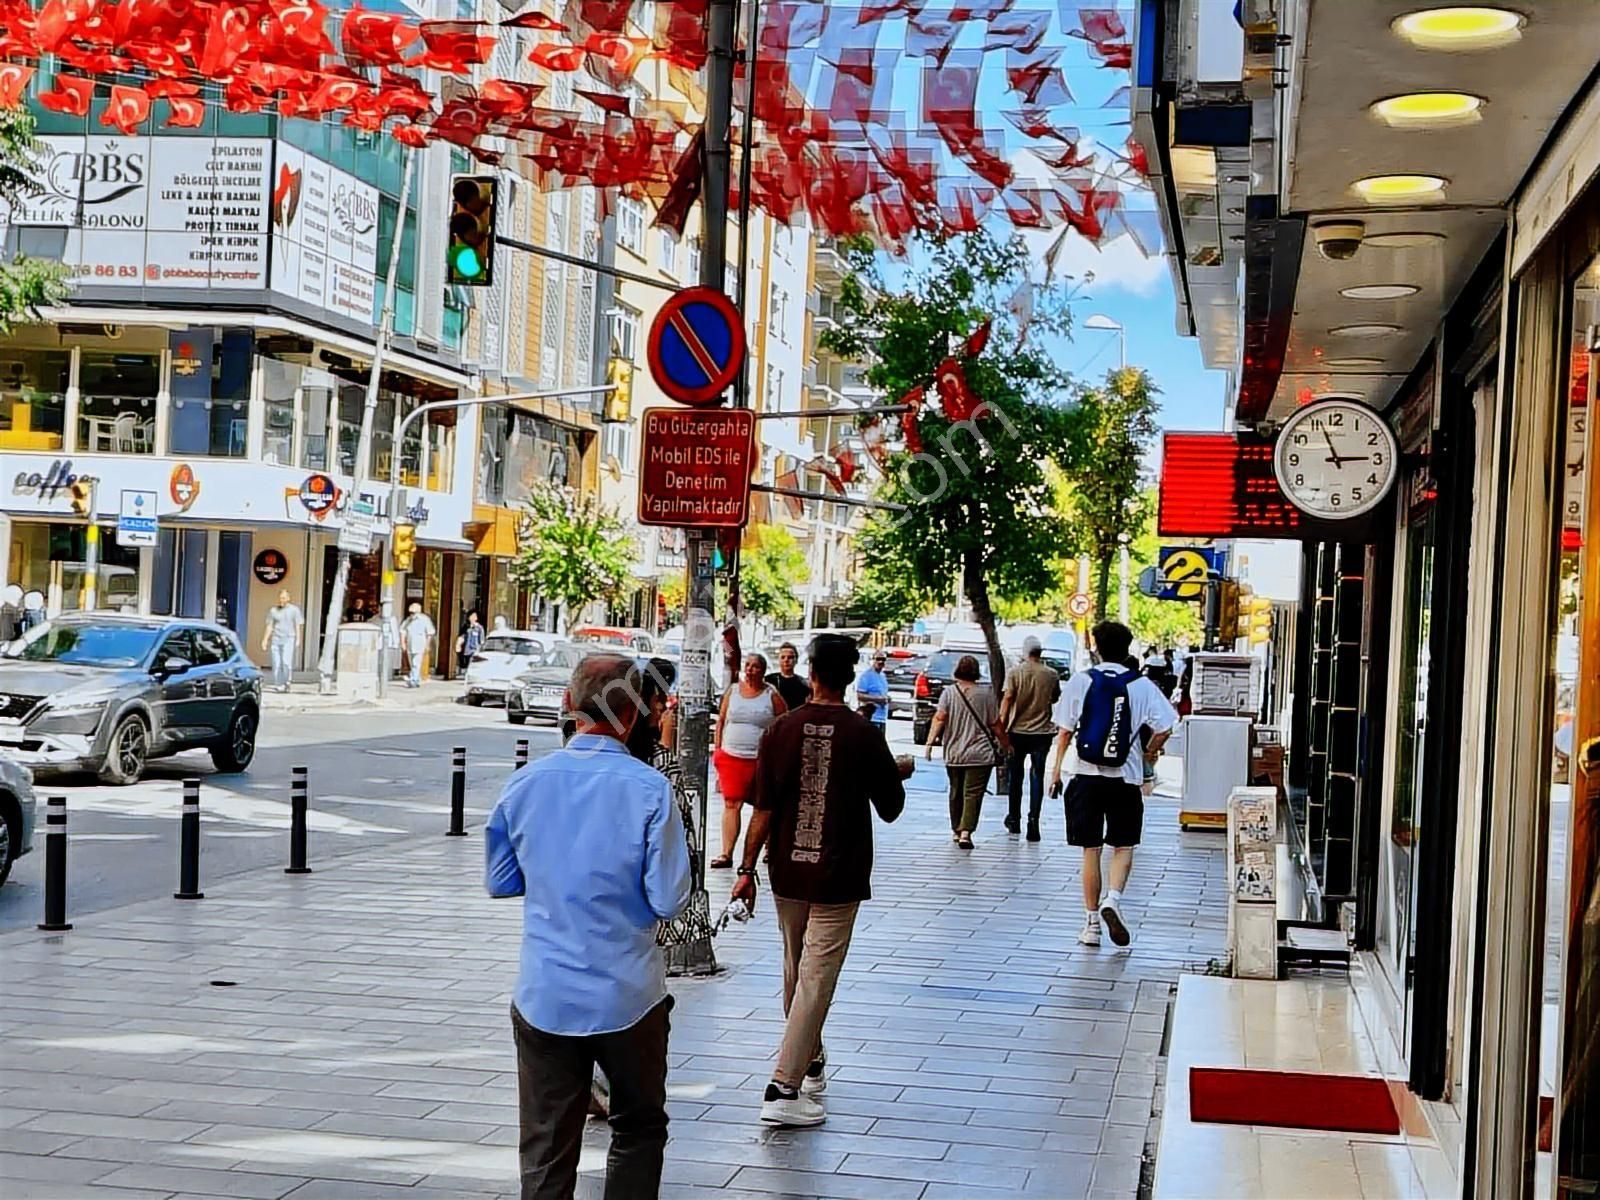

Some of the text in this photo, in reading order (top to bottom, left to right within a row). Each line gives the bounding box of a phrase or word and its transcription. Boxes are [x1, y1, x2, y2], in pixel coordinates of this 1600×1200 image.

[71, 153, 144, 184] BBS
[223, 207, 260, 217] MAKYAJ
[72, 211, 144, 228] SALONU
[225, 222, 259, 232] TIRNAK
[118, 265, 137, 277] 83
[648, 416, 667, 435] Bu
[1311, 419, 1320, 432] 11
[1328, 413, 1343, 427] 12
[1367, 432, 1379, 446] 2
[651, 445, 741, 466] Mobil EDS ile
[1289, 453, 1300, 467] 9
[1372, 452, 1383, 466] 3
[665, 470, 727, 491] Denetim
[1294, 473, 1304, 487] 8
[1366, 472, 1378, 486] 4
[1330, 493, 1341, 507] 6
[1351, 487, 1363, 500] 5
[644, 493, 742, 518] Yapılmaktadır
